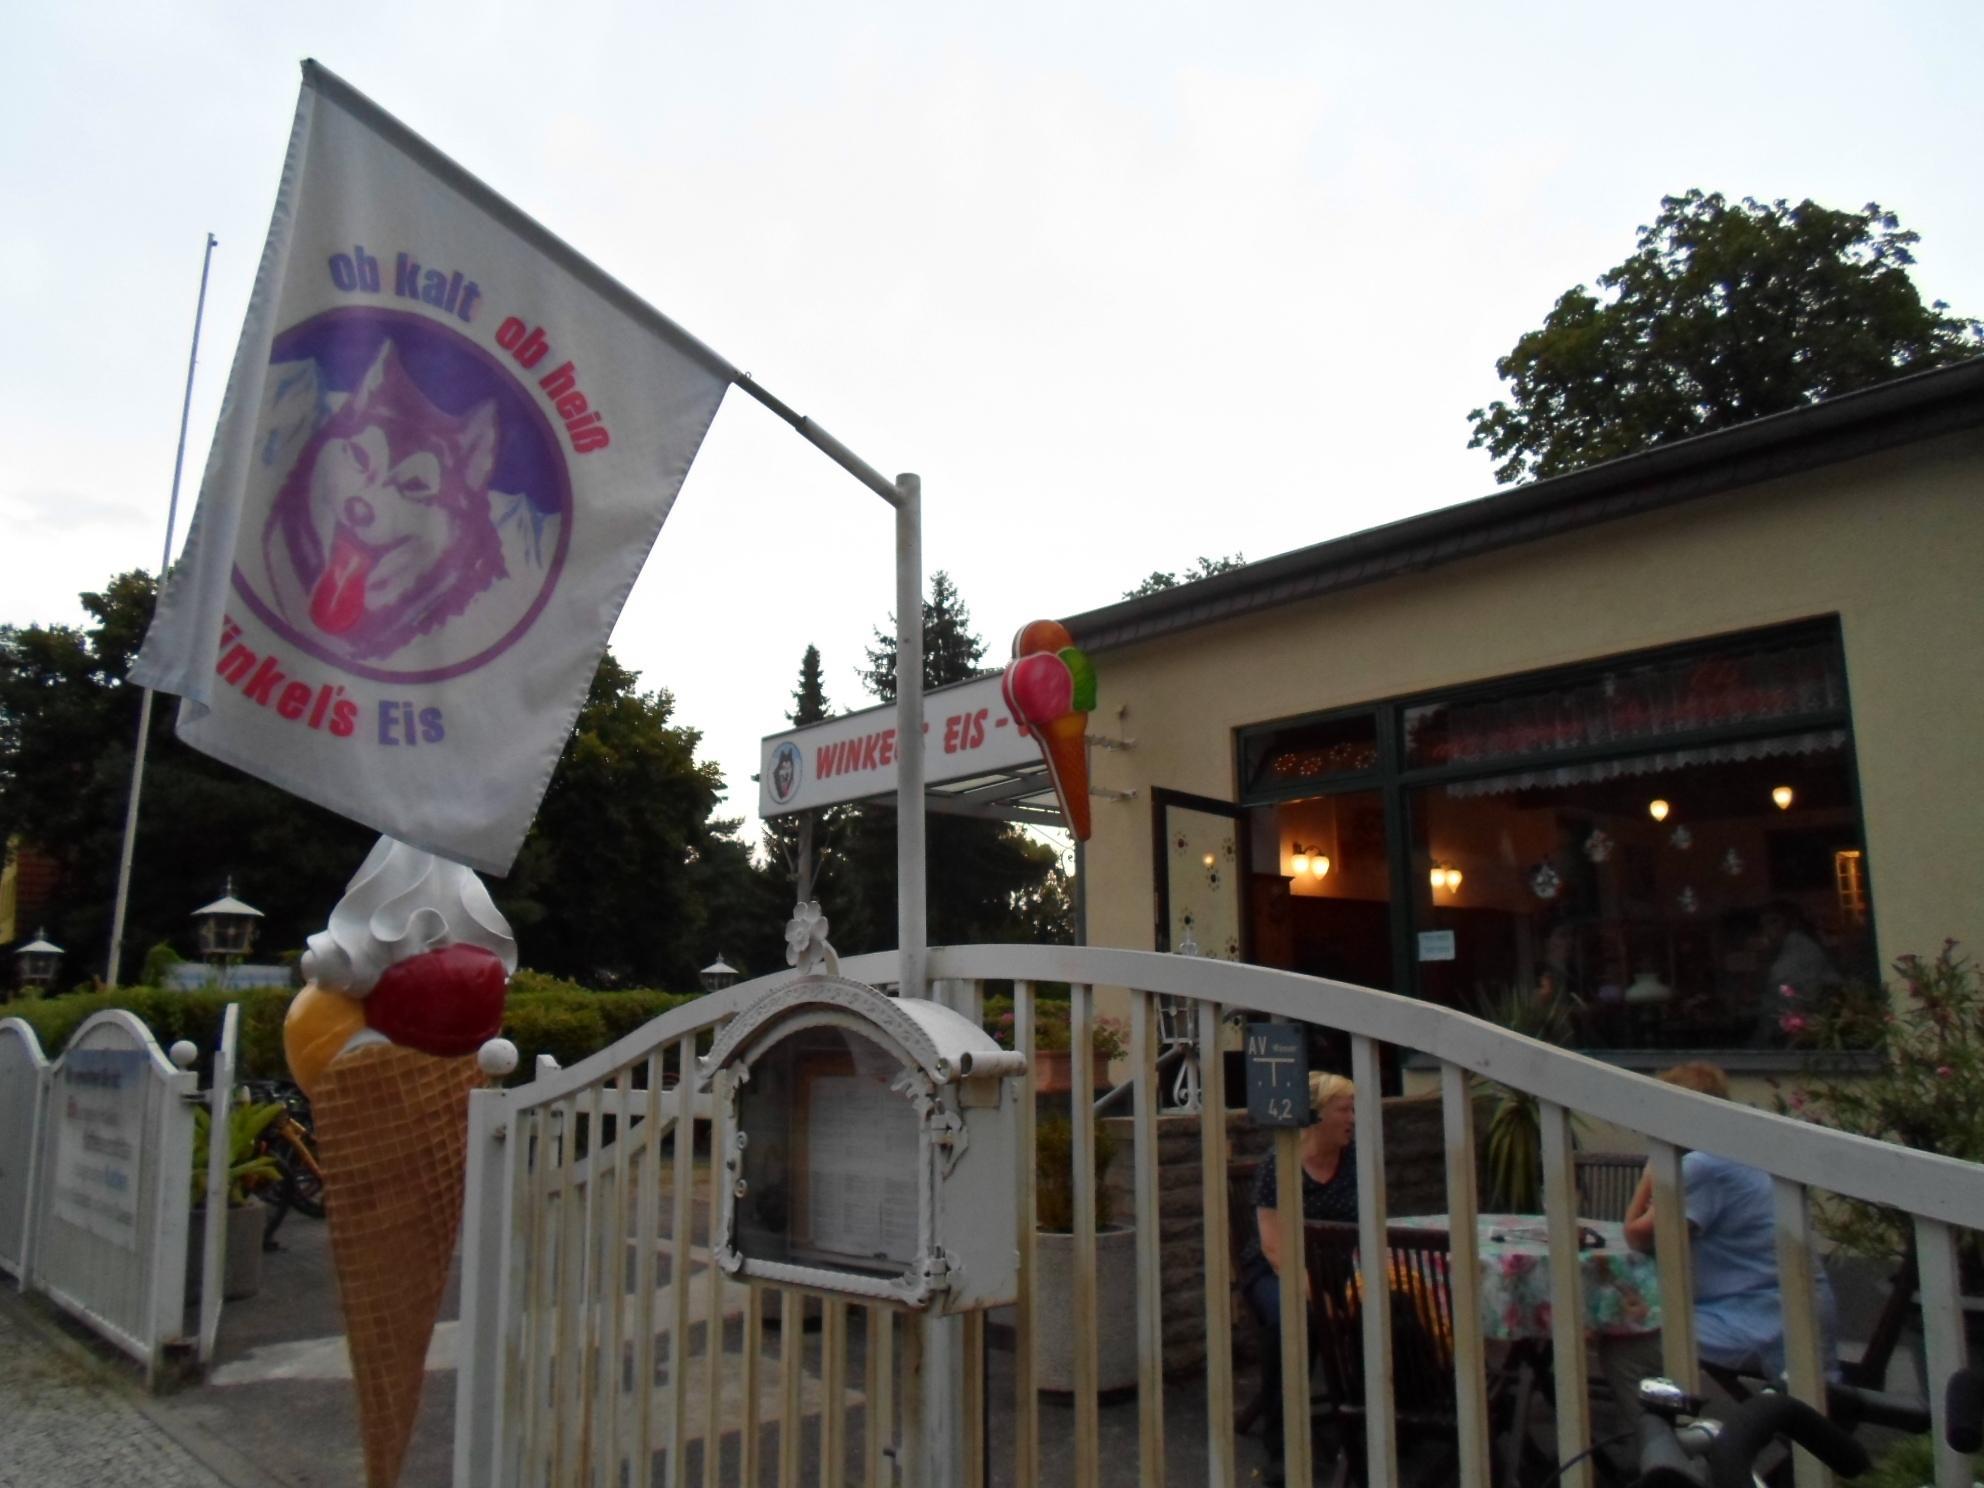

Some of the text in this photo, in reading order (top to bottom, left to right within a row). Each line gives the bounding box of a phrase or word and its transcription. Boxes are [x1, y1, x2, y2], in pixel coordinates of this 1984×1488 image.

[328, 245, 610, 454] ob kalt ob heiß
[216, 614, 446, 746] inkel's Eis
[1248, 1036, 1267, 1055] AV
